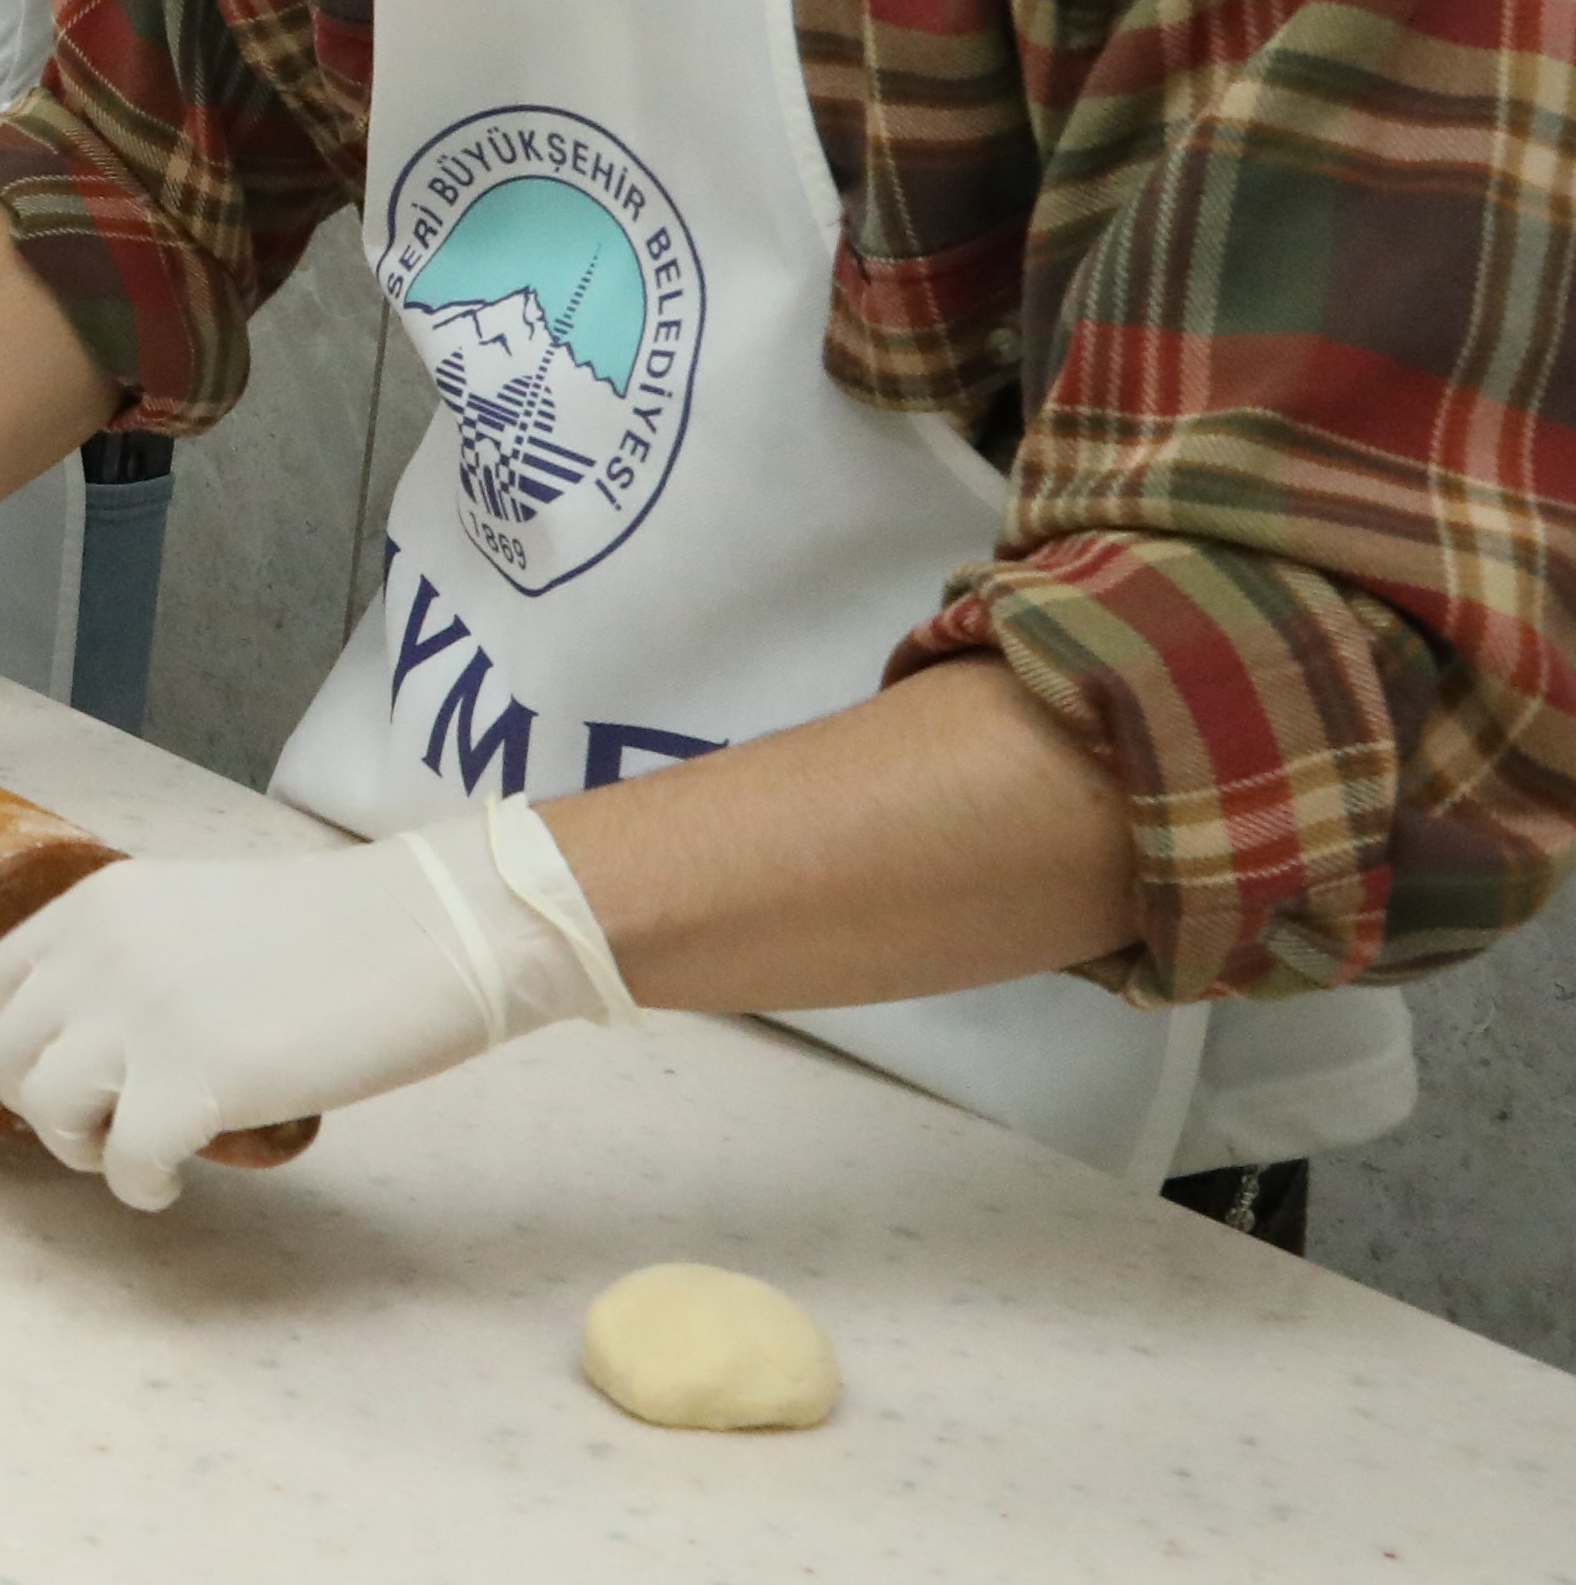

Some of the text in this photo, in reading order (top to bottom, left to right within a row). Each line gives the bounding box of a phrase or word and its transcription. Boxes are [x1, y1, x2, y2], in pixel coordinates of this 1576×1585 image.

[385, 127, 684, 512] SERİ BÜYÜKŞEHİR BELEDİYESİ
[469, 511, 527, 571] 1869
